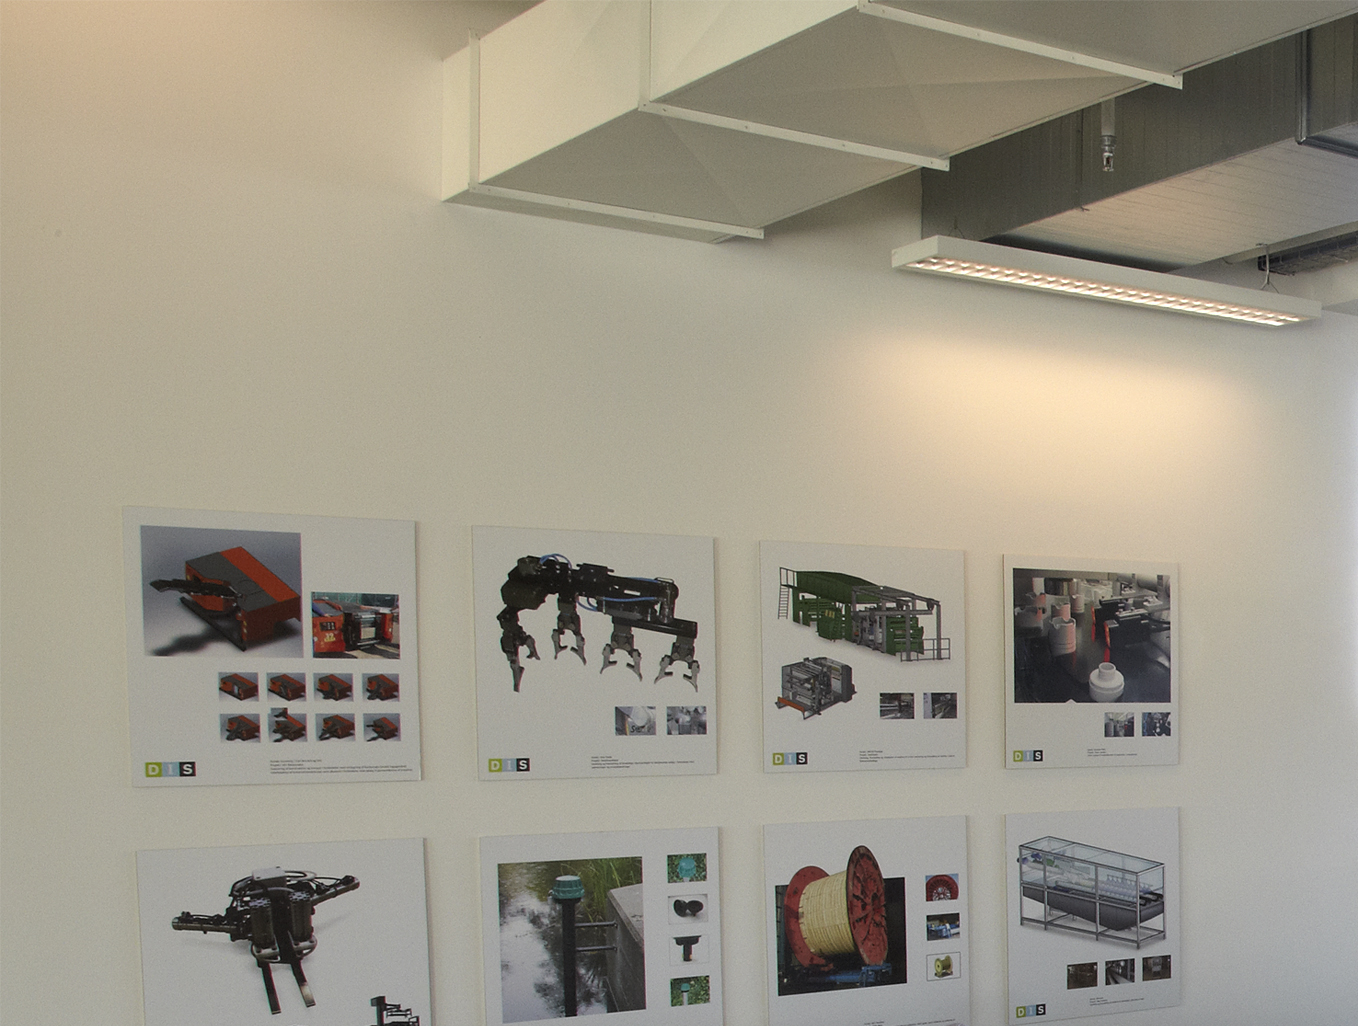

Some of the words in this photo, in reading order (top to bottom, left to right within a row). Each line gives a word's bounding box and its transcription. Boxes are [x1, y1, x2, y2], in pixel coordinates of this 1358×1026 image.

[774, 753, 806, 764] DIS
[1014, 751, 1042, 761] DIS
[147, 763, 193, 776] DIS
[490, 759, 528, 771] DIS
[1017, 1005, 1045, 1015] DIS
